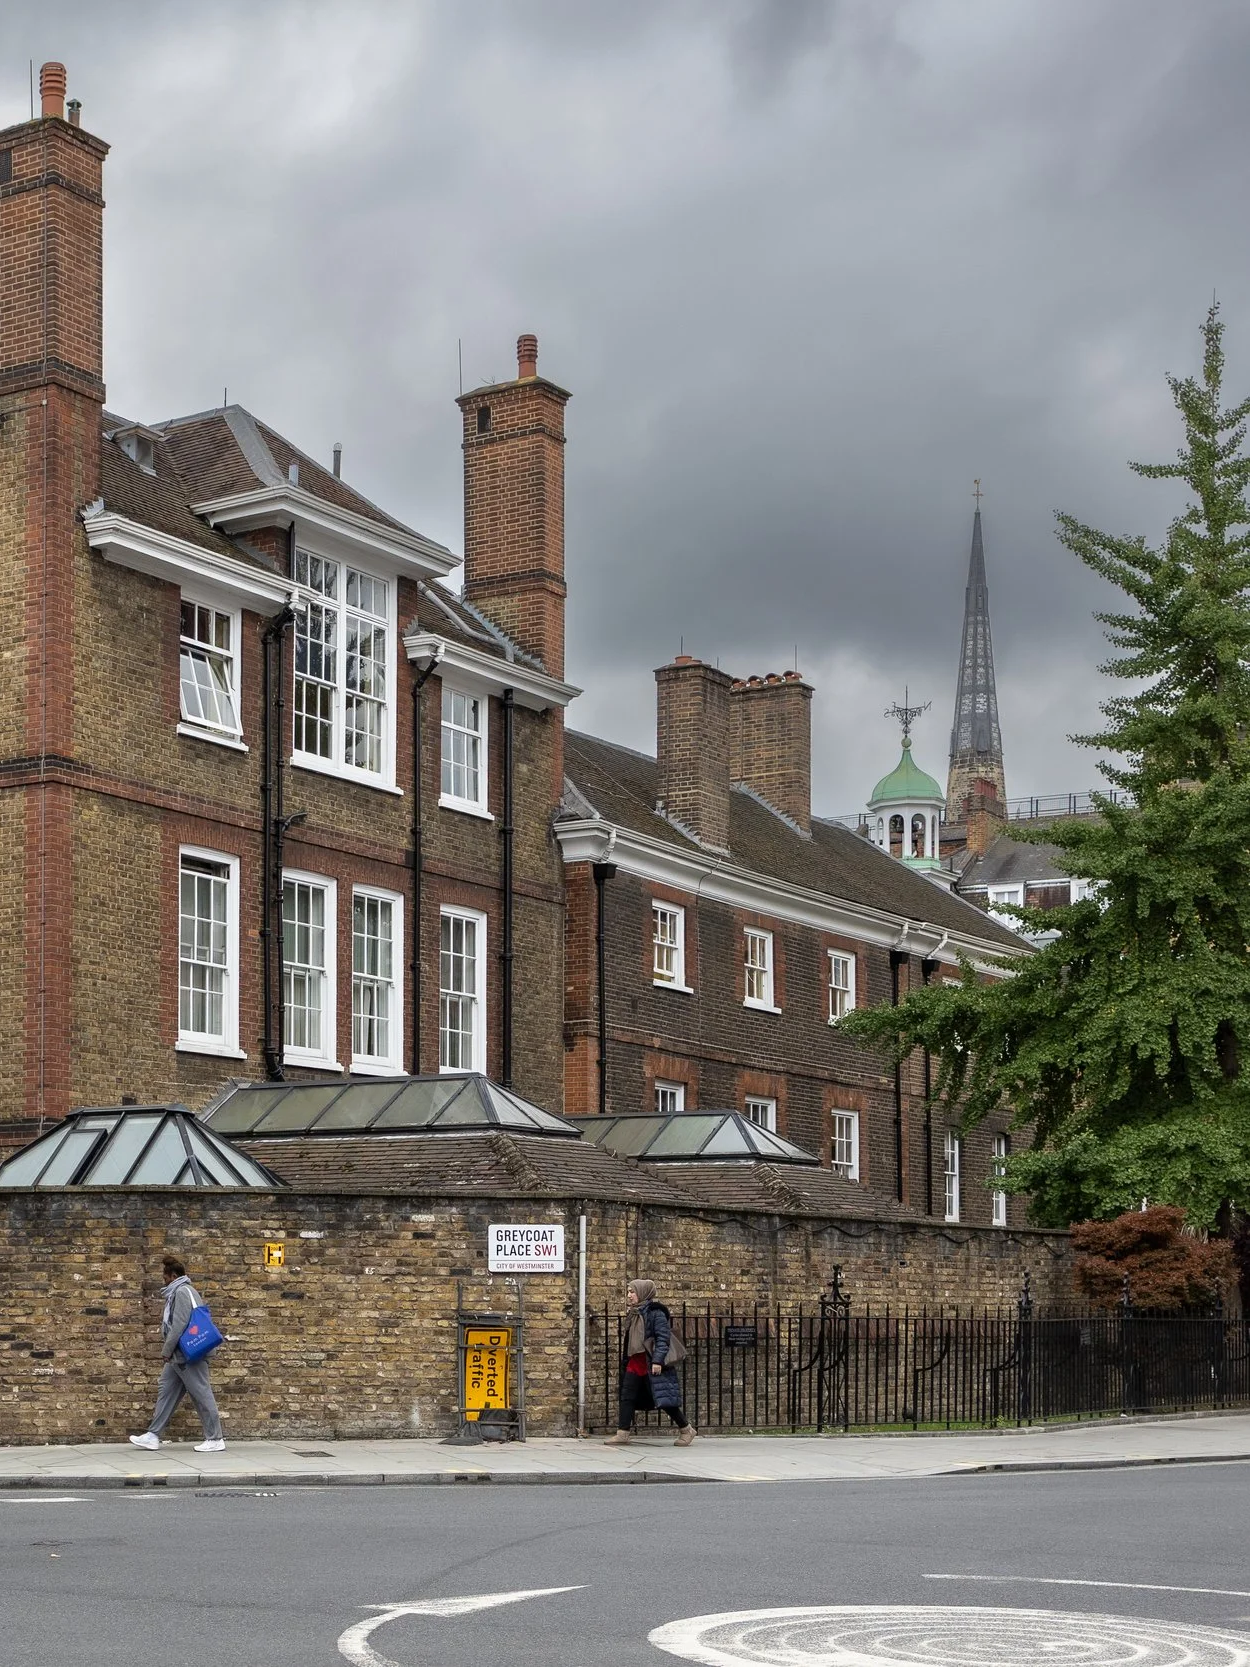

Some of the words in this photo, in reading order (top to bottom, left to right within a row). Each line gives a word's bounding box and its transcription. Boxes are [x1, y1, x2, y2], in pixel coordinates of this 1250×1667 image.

[496, 1230, 555, 1242] GREYCOAT
[496, 1244, 532, 1256] PLACE
[534, 1244, 557, 1256] SW1
[486, 1335, 501, 1397] Dverted
